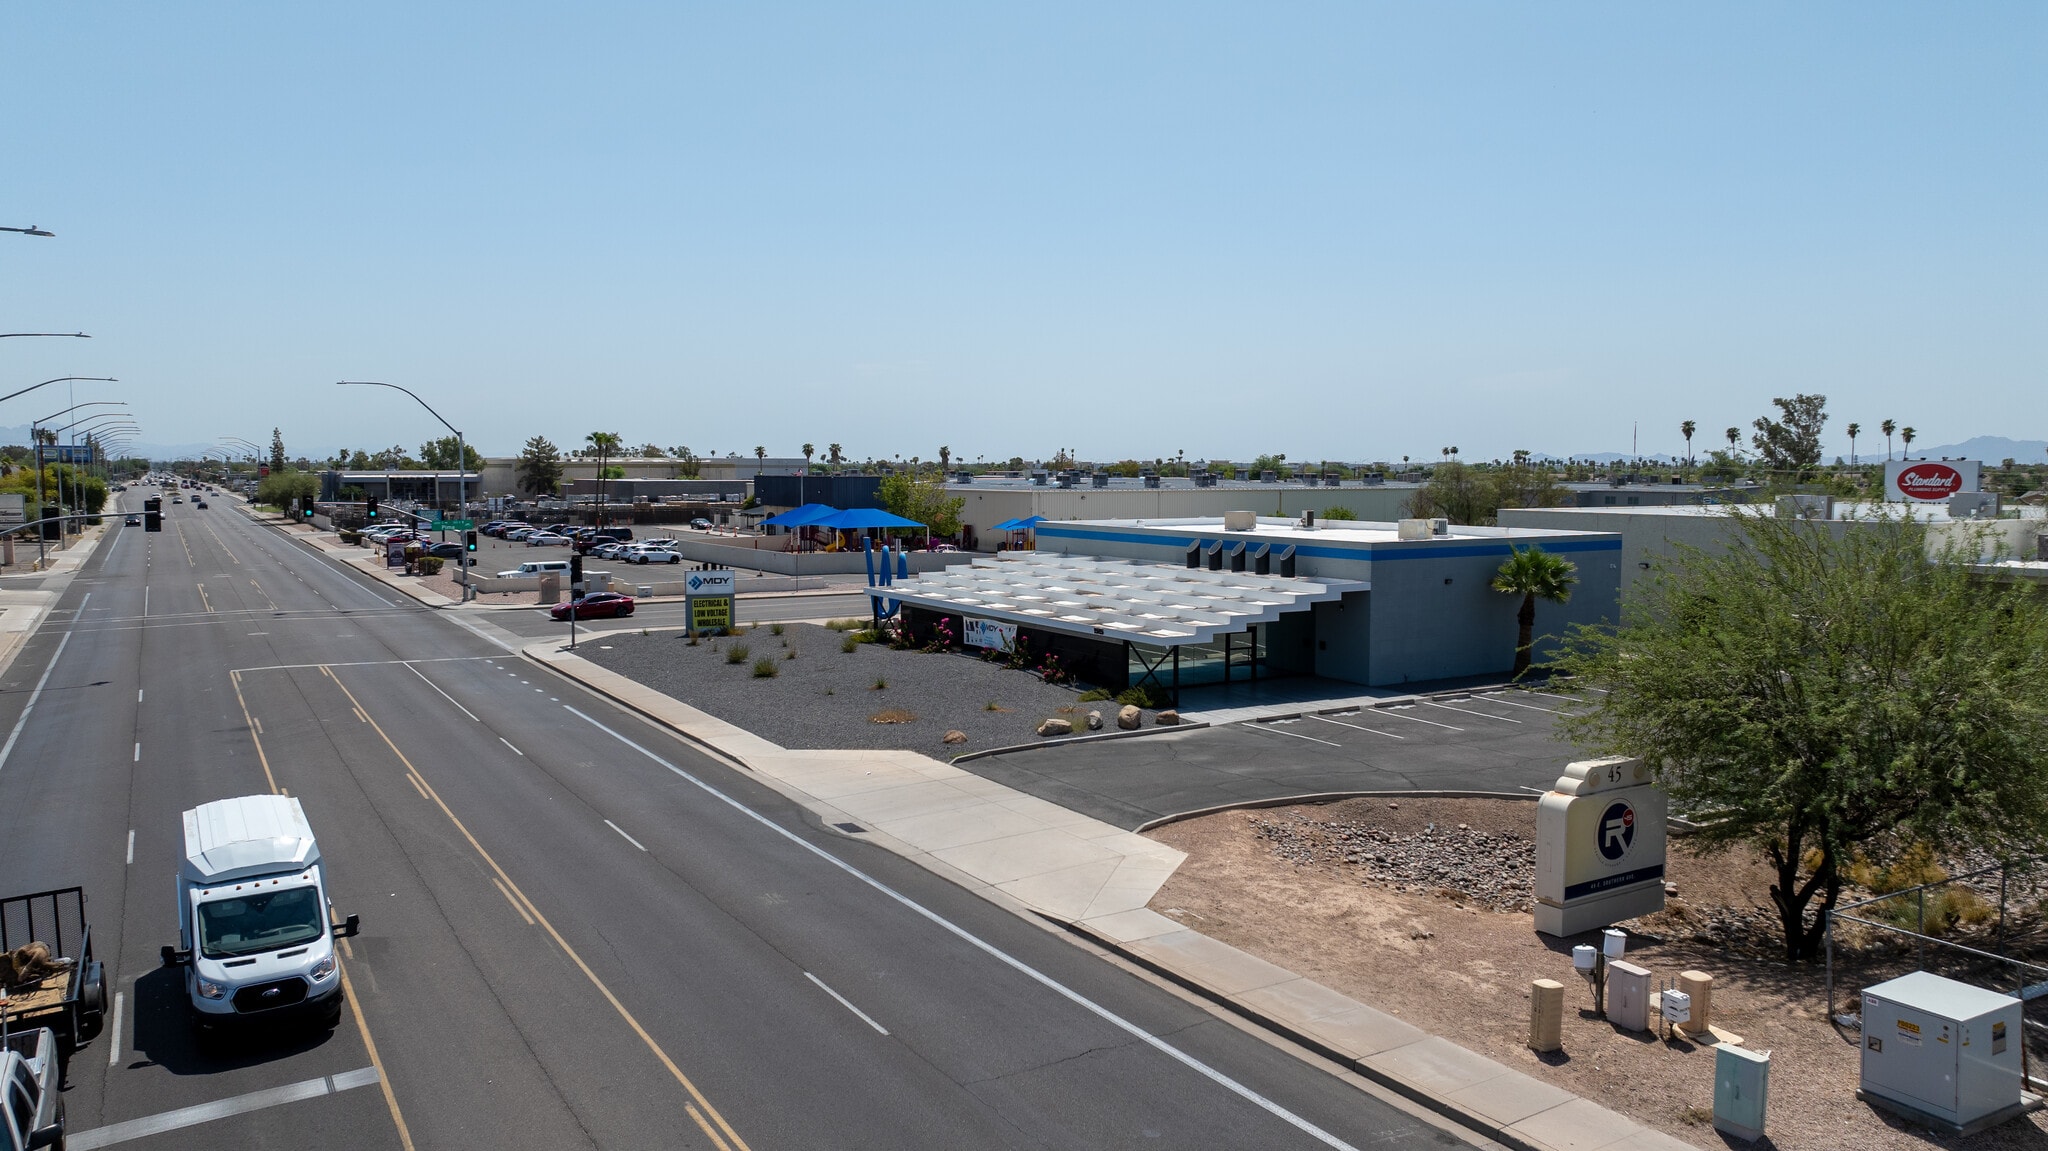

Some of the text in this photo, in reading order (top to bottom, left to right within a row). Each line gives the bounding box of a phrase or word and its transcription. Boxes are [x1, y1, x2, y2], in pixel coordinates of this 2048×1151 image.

[1901, 472, 1956, 487] Standard
[723, 599, 728, 607] &
[707, 609, 728, 617] VOLTAGE
[697, 618, 726, 627] WHOLESALE
[1608, 766, 1621, 783] 45
